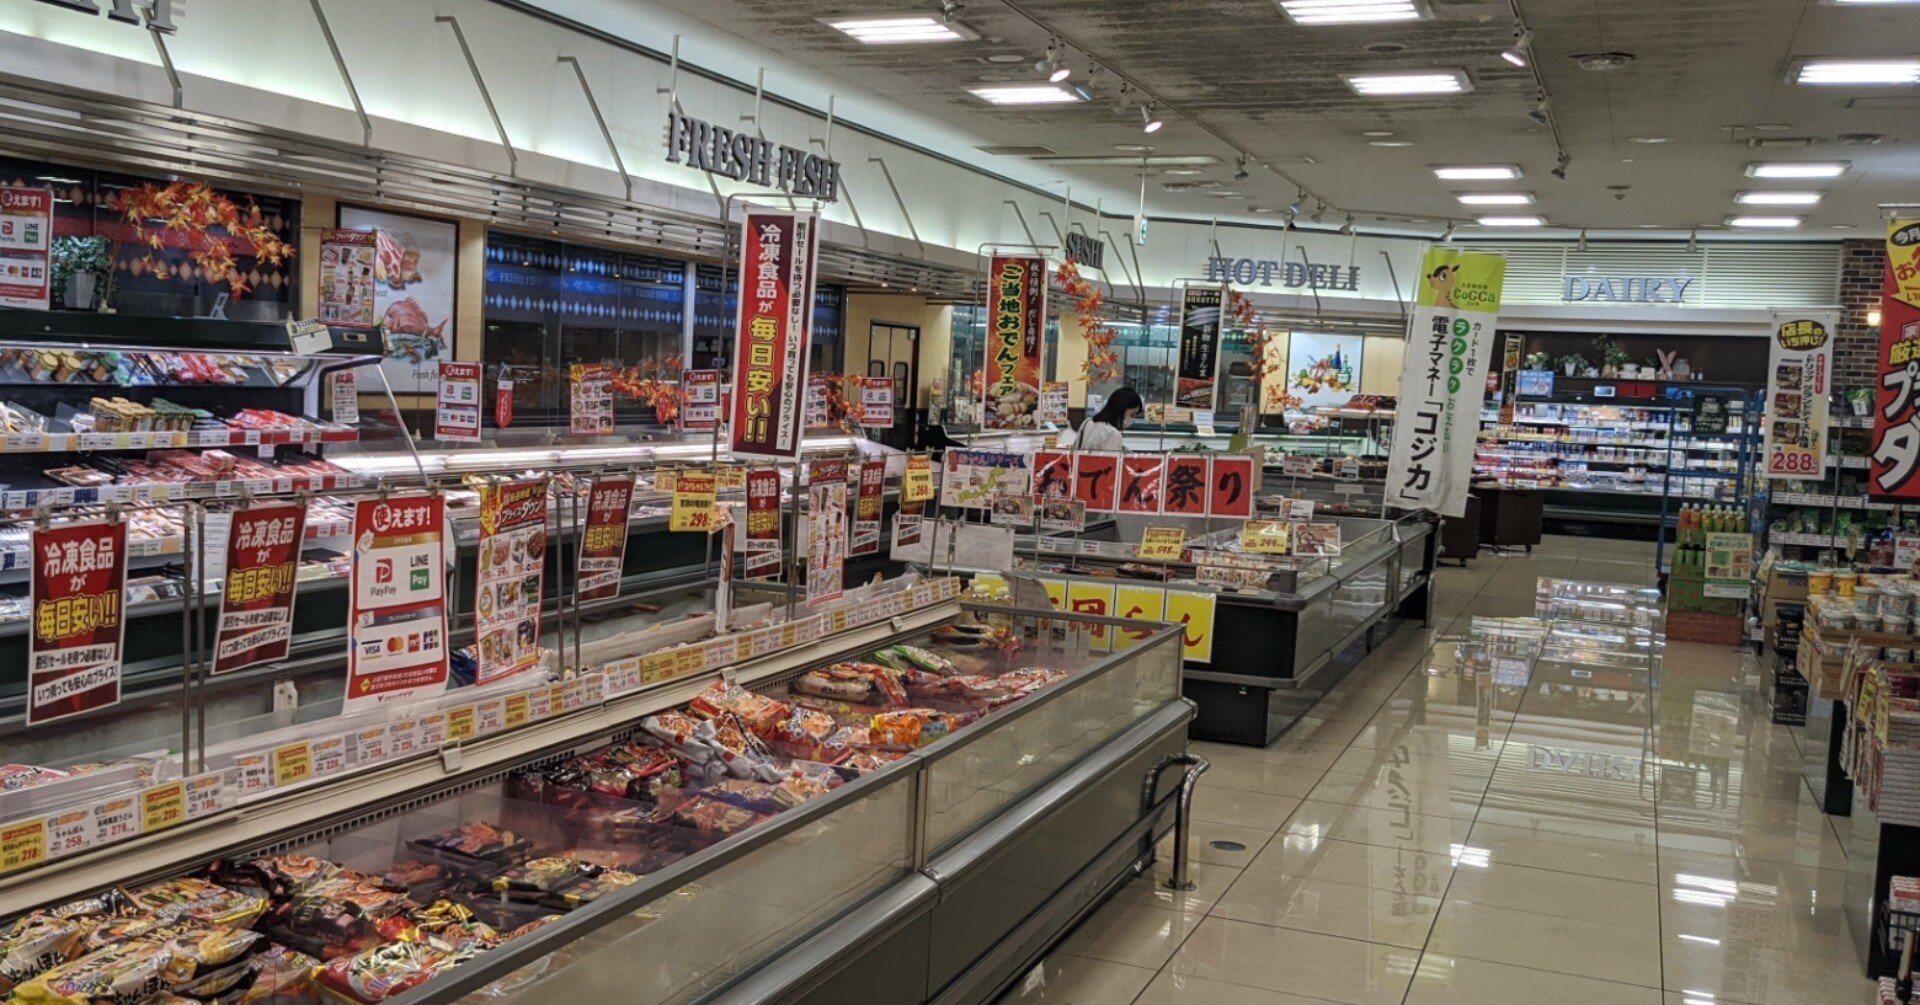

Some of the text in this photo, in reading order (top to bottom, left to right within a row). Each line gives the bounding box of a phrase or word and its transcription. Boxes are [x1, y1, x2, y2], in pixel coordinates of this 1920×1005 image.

[665, 111, 841, 204] FRESH FISH
[1065, 231, 1104, 269] SUSHI
[1206, 256, 1361, 291] HOT DELI
[1561, 275, 1694, 303] DAIRY
[996, 263, 1024, 397] ご当地おでんフェア
[1780, 321, 1823, 337] 店長の
[1399, 316, 1449, 500] 電子マネー「コジカ」
[1771, 452, 1813, 472] 288
[372, 503, 431, 532] 使えます!
[236, 517, 296, 550] 冷凍食品
[43, 536, 114, 577] 冷凍食品
[256, 549, 271, 563] が
[410, 554, 429, 567] LINE
[69, 573, 88, 592] が
[228, 562, 295, 604] 毎日安い!!
[370, 585, 397, 597] PayPay
[412, 573, 428, 588] Pay
[37, 591, 119, 641] 毎日安い!!
[364, 644, 381, 655] VISA
